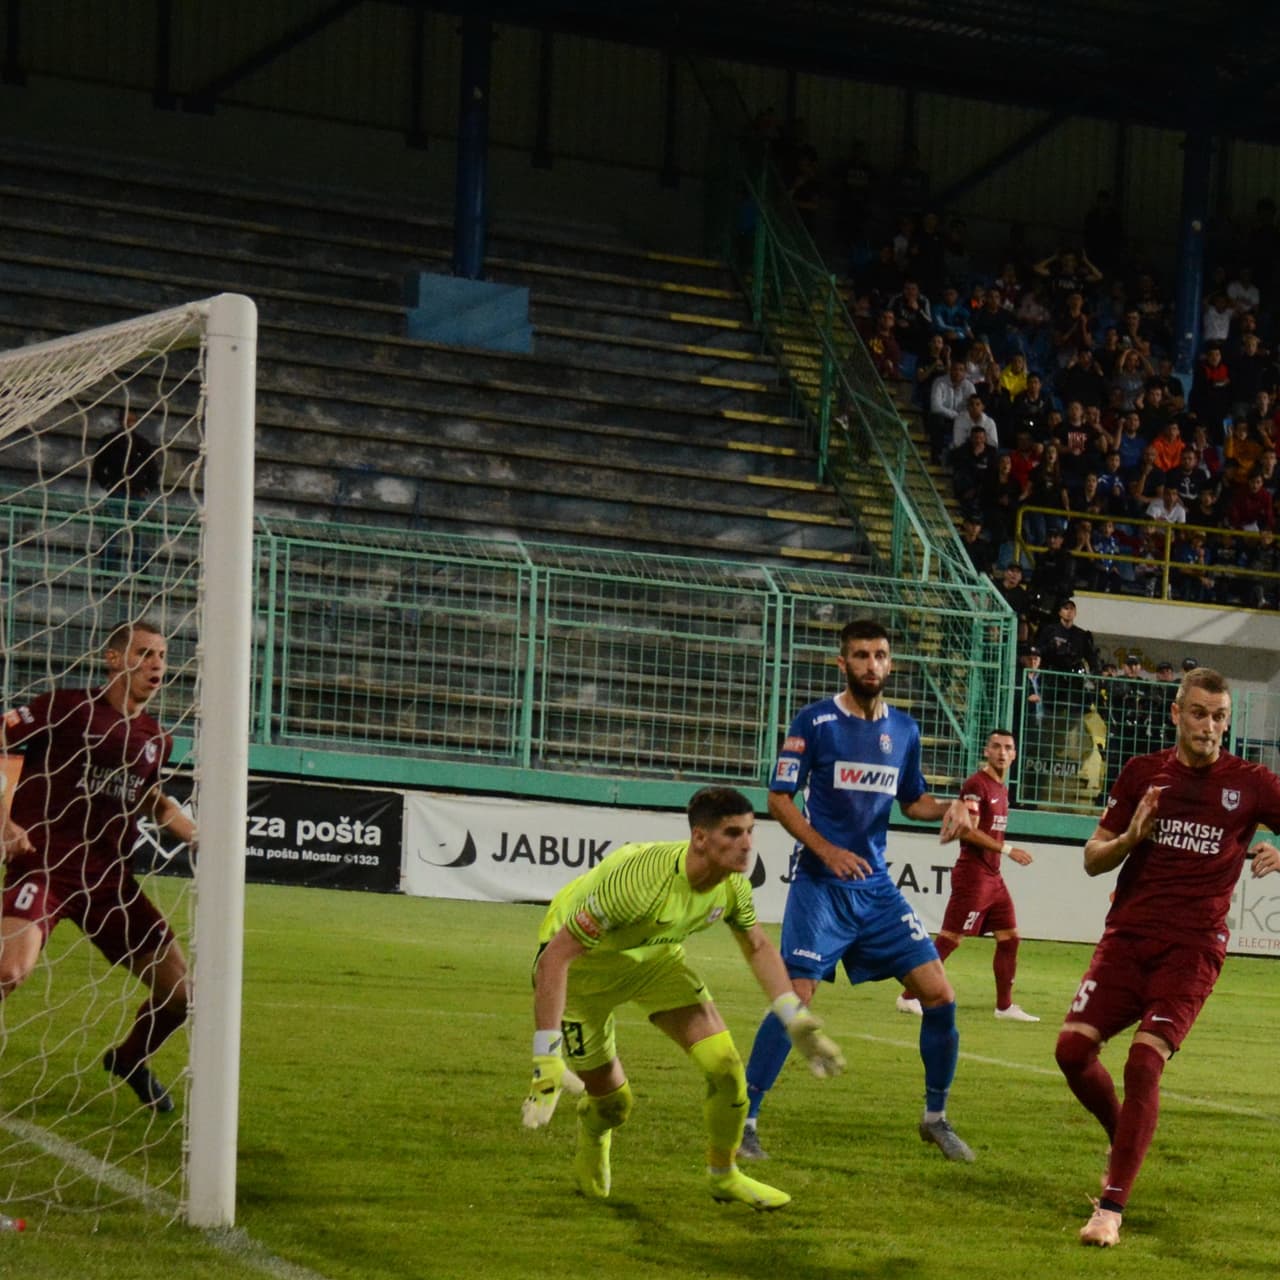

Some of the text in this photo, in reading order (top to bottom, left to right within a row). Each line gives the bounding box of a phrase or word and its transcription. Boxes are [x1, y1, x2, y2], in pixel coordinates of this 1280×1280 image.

[296, 815, 382, 846] pošta
[266, 846, 300, 861] pošta
[302, 850, 341, 864] Mostar
[353, 854, 380, 866] 1323
[14, 882, 39, 911] 6
